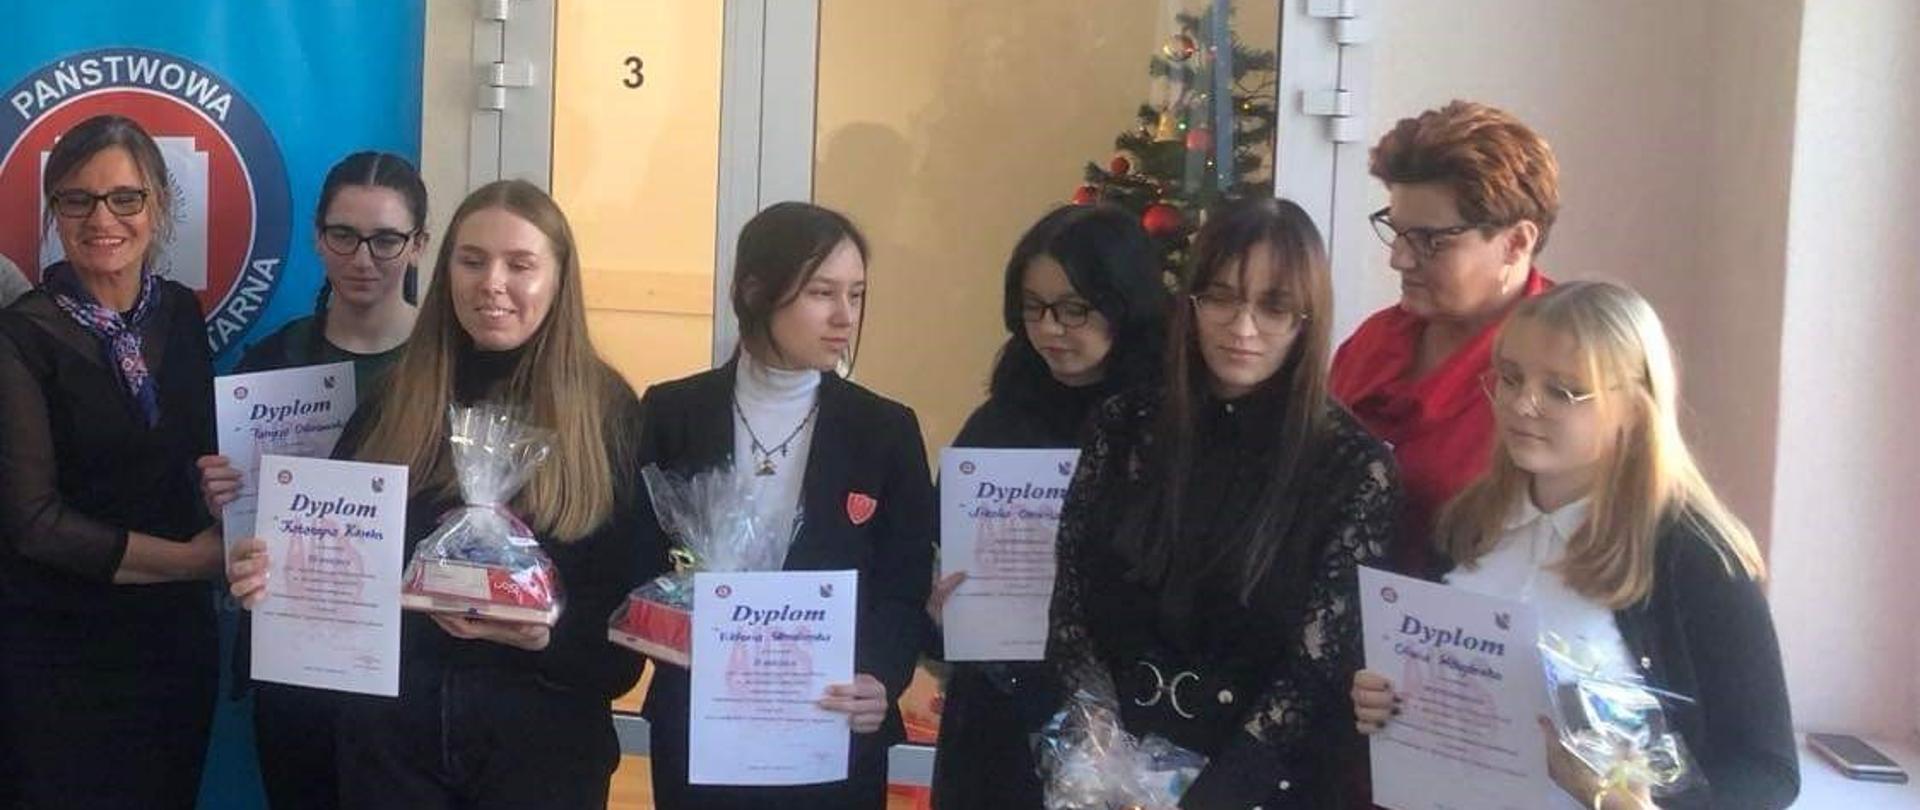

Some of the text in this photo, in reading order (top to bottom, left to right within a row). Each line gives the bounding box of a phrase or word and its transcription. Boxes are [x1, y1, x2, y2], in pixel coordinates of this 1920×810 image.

[11, 55, 233, 121] PAŃSTWOWA
[623, 56, 644, 89] 3
[207, 258, 280, 352] TARNA
[250, 399, 331, 422] Dyplom
[290, 494, 377, 518] Dyplom
[732, 604, 826, 626] Dyplom
[1400, 615, 1504, 656] Dyplom
